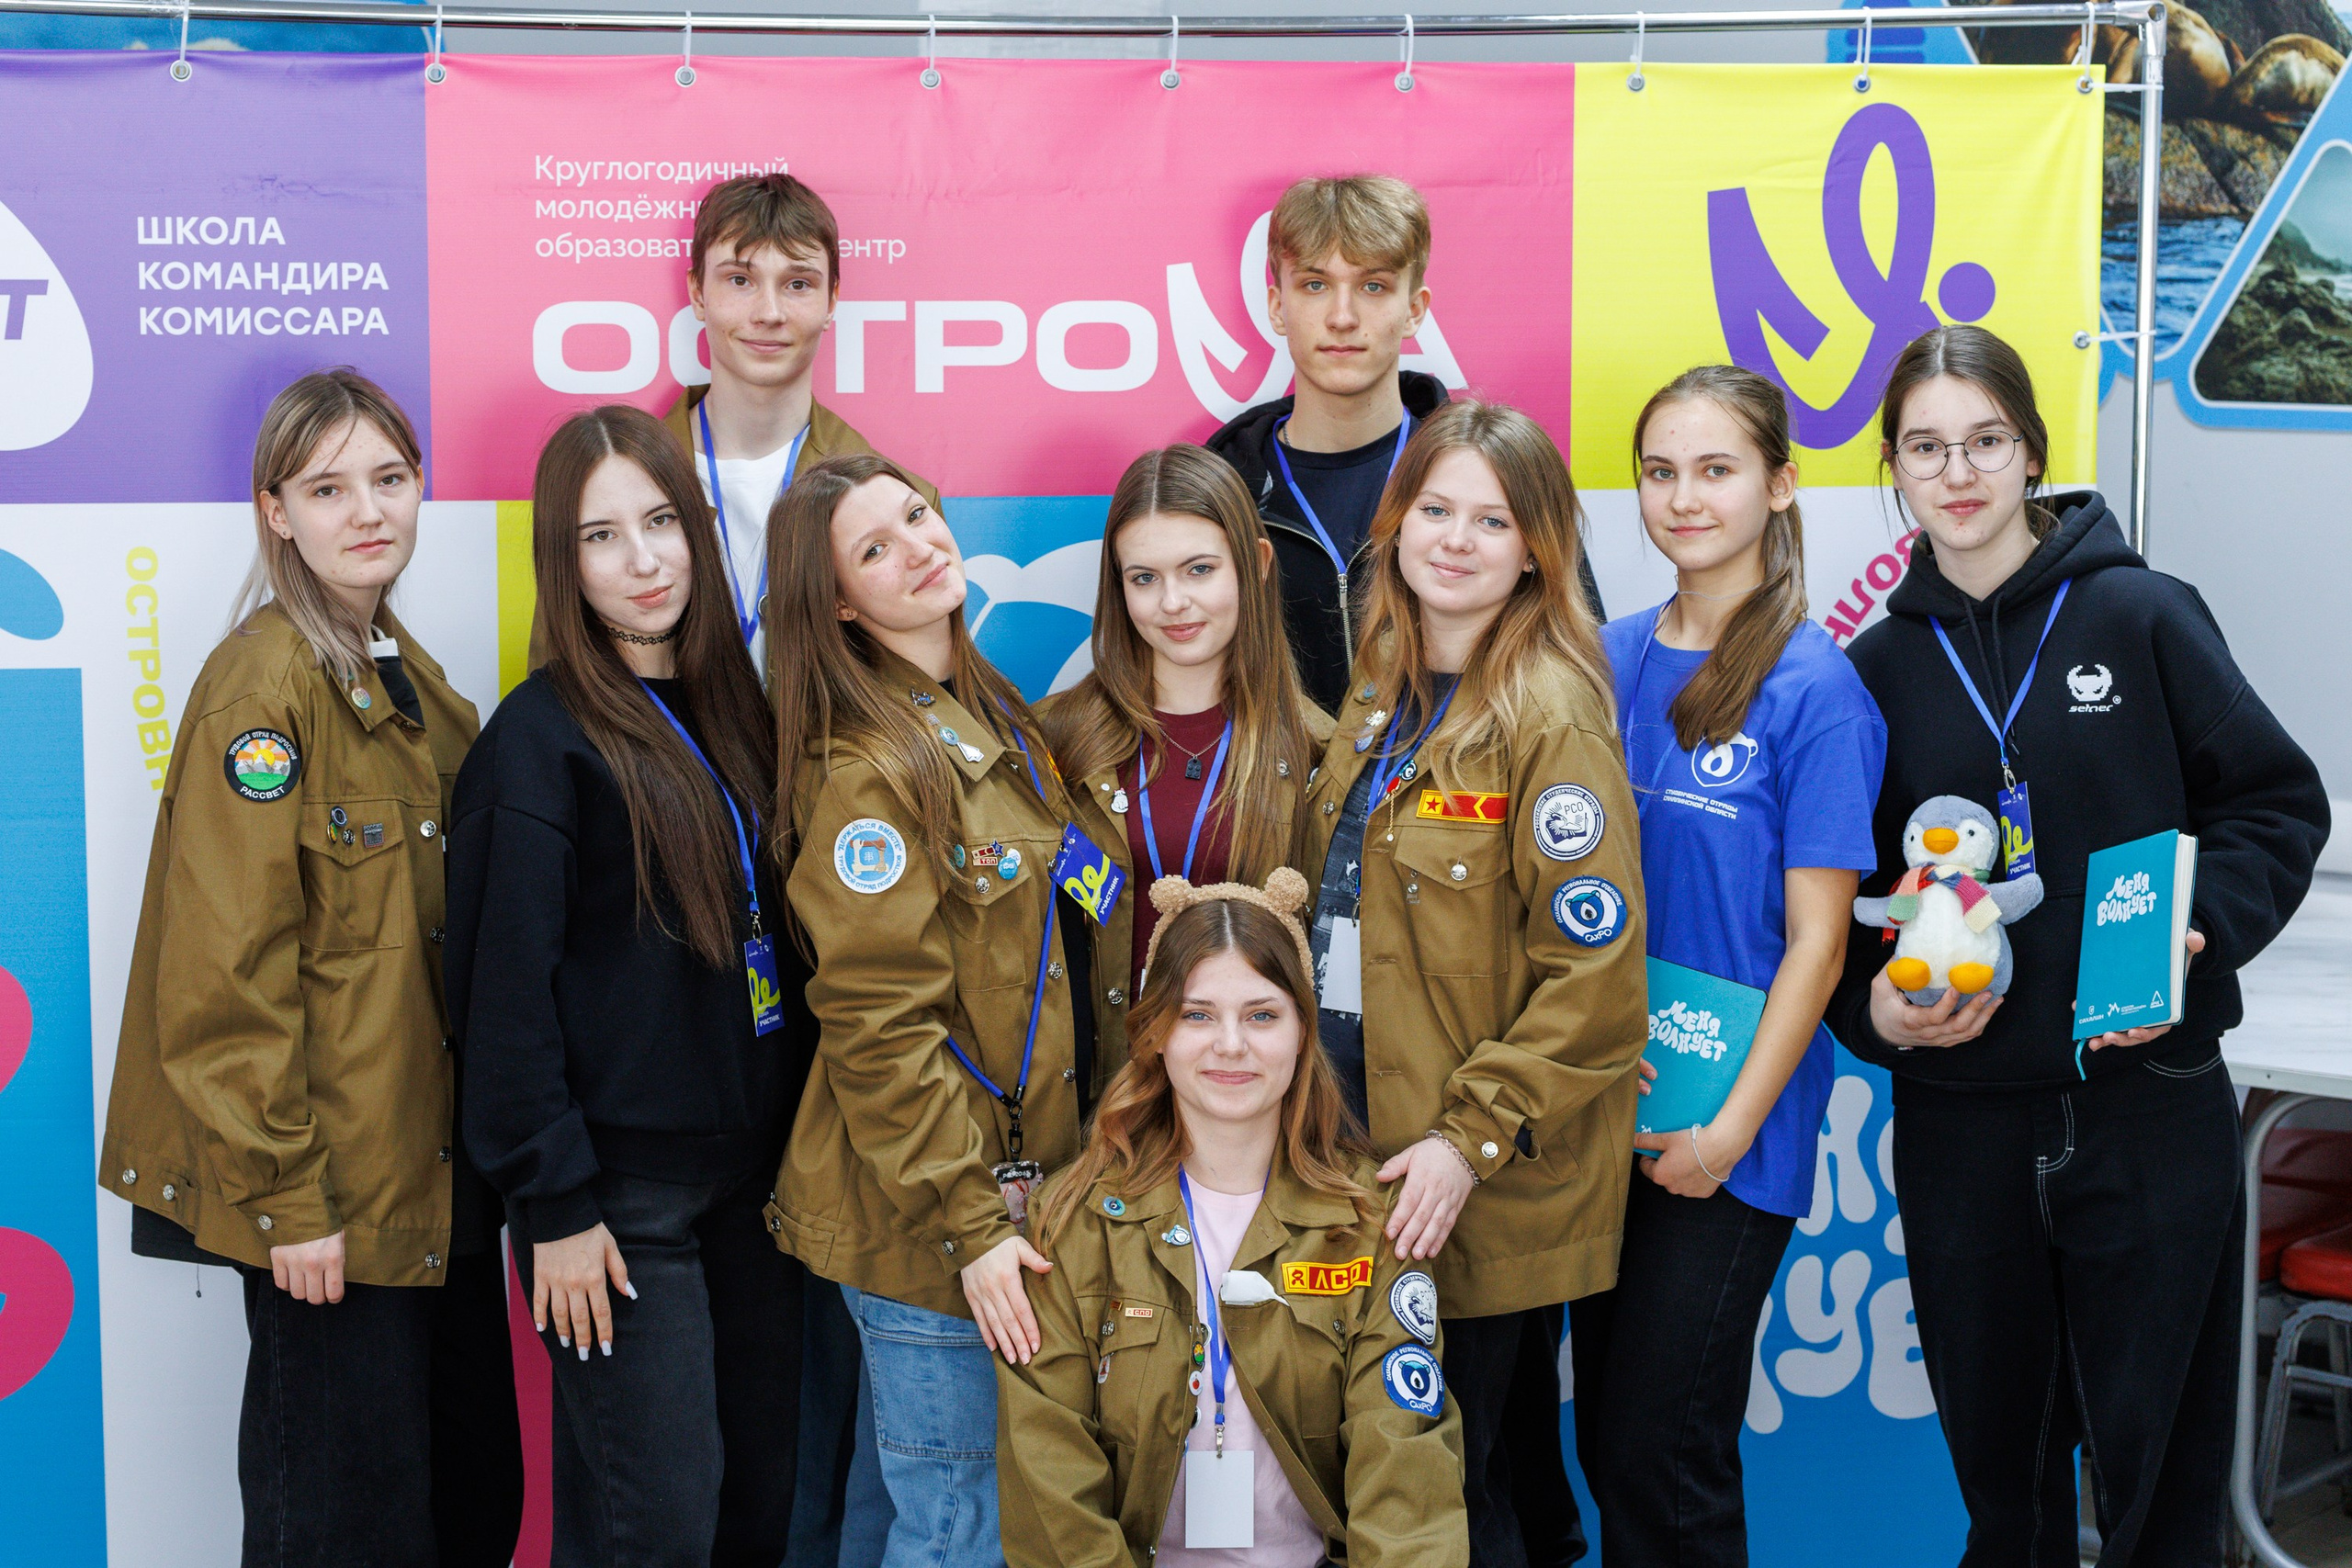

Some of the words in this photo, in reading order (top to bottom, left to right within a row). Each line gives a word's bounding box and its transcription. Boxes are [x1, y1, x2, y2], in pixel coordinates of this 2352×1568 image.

[535, 155, 789, 186] Круглогодичный
[535, 194, 698, 222] молодёжн
[137, 216, 286, 246] ШКОЛА
[138, 262, 390, 295] КОМАНДИРА
[140, 307, 390, 335] КОМИССАРА
[229, 733, 251, 755] ТРУДОВОЙ
[240, 785, 285, 799] РАССВЕТ
[1665, 788, 1709, 804] СТУДЕНЧЕСКИЕ
[1710, 799, 1738, 813] ОТРЯДЫ
[1564, 801, 1584, 815] РСО
[1663, 795, 1704, 809] САХАЛИНСКОЙ
[1705, 806, 1736, 819] ОБЛАСТИ
[838, 855, 856, 886] ТРУДОВОЙ
[855, 882, 876, 890] ОТРЯД
[877, 855, 902, 887] ПОДРОСТКОВ
[2009, 862, 2031, 874] УЧАСТНИК
[1100, 875, 1120, 915] УЧАСТНИК
[1562, 879, 1601, 893] РЕГИОНАЛЬНОЕ
[2105, 871, 2150, 900] МЕНЯ
[2097, 891, 2157, 927] ВОЛНУЕТ
[759, 1014, 780, 1027] УЧАСТНИК
[1657, 1000, 1721, 1038] МЕНЯ
[2078, 1013, 2105, 1024] САХАЛИН
[1647, 1014, 1727, 1062] ВОЛНУЕТ
